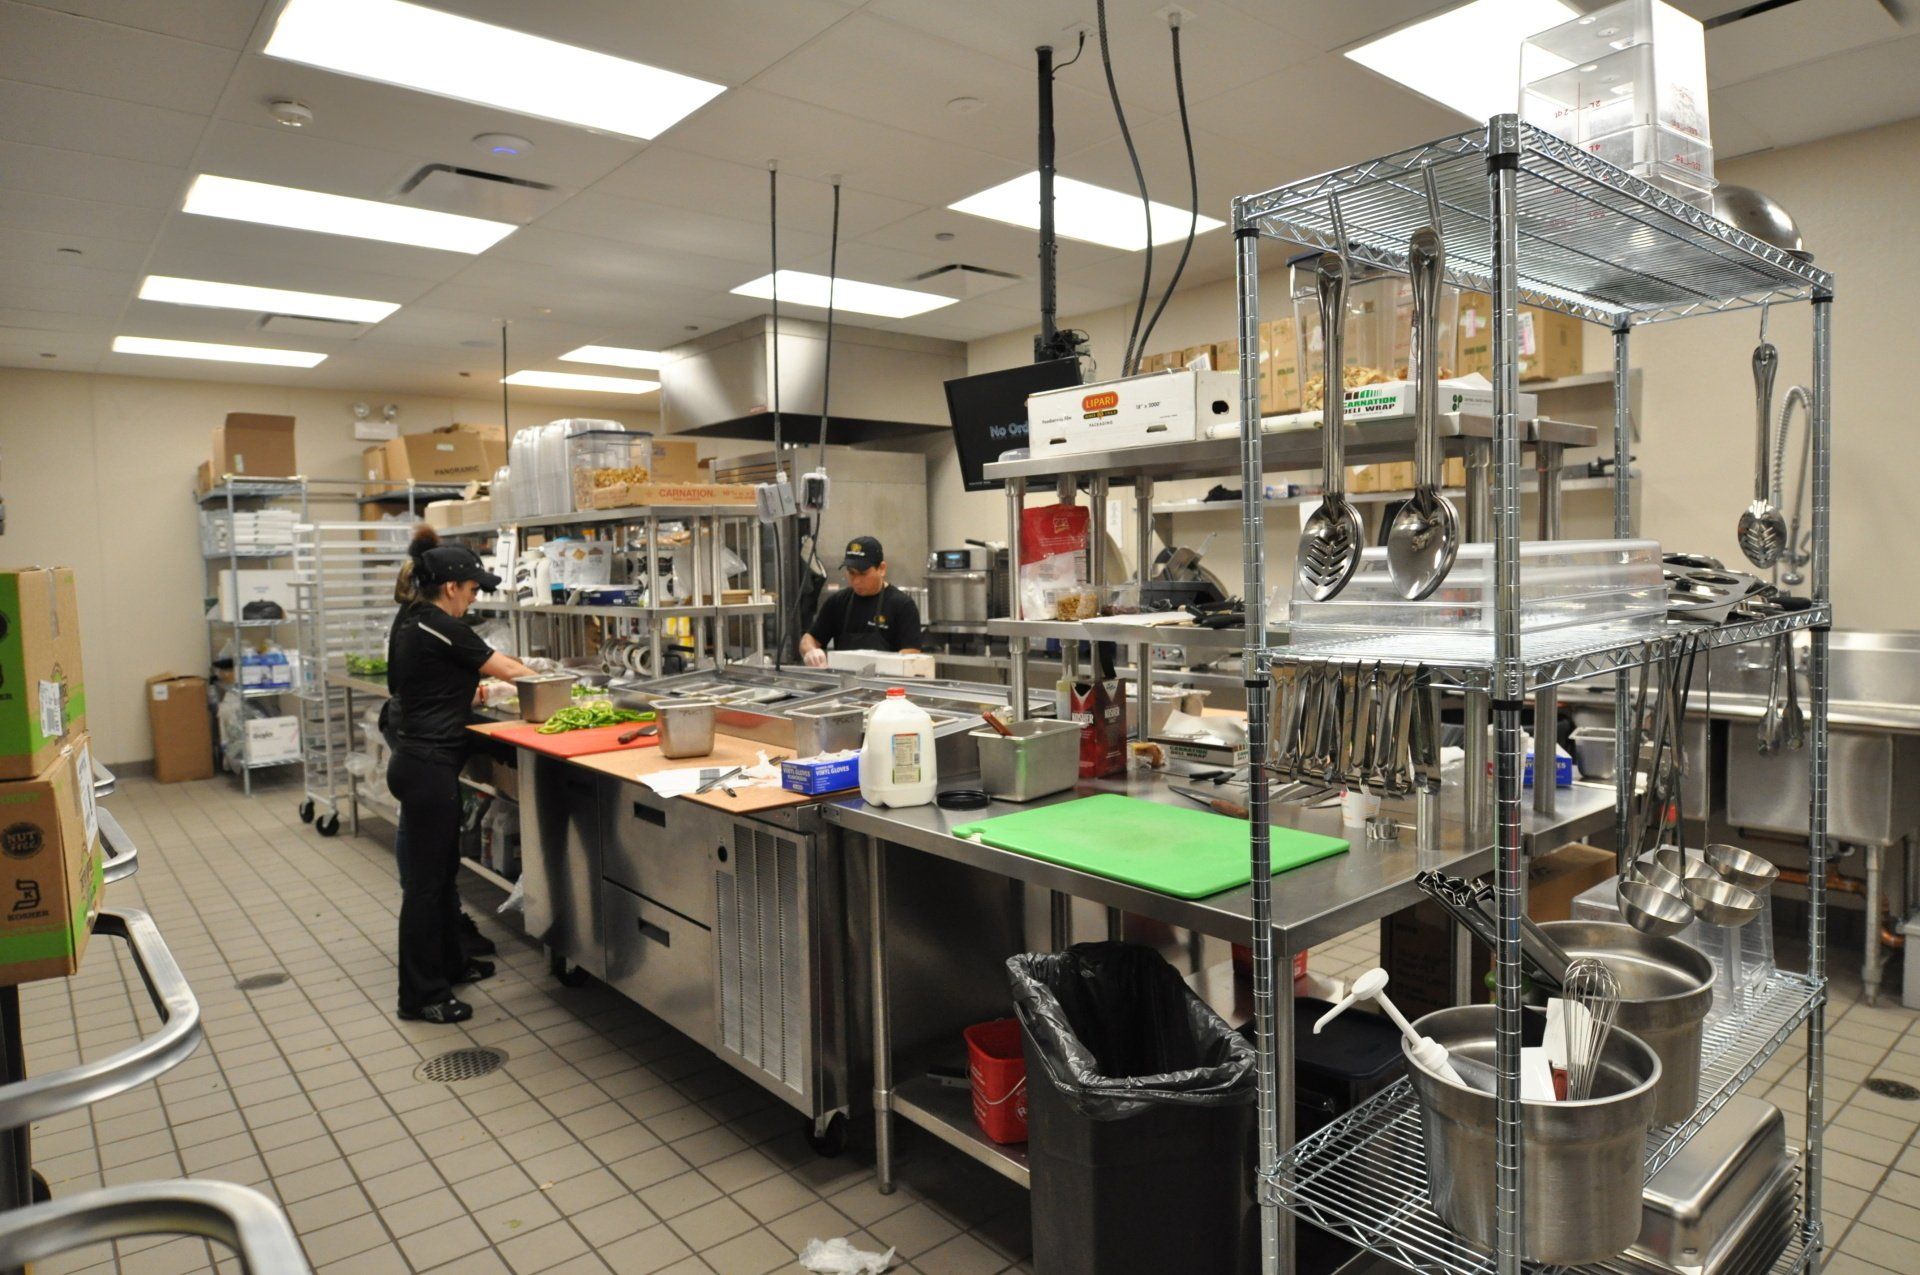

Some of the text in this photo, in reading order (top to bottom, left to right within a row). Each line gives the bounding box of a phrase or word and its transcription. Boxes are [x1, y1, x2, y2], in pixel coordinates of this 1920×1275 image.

[1086, 394, 1114, 409] LIPARI
[1365, 403, 1395, 412] WRAP
[1089, 420, 1113, 428] PACKAGING
[990, 425, 1007, 438] No
[434, 465, 480, 476] PANORAMIC
[657, 488, 713, 498] CARNATION
[1071, 712, 1094, 724] KOSHER
[1104, 706, 1120, 718] KOSHER
[815, 765, 850, 777] VINYL GLOVES
[7, 832, 37, 843] NUT
[7, 910, 49, 922] KOSHER
